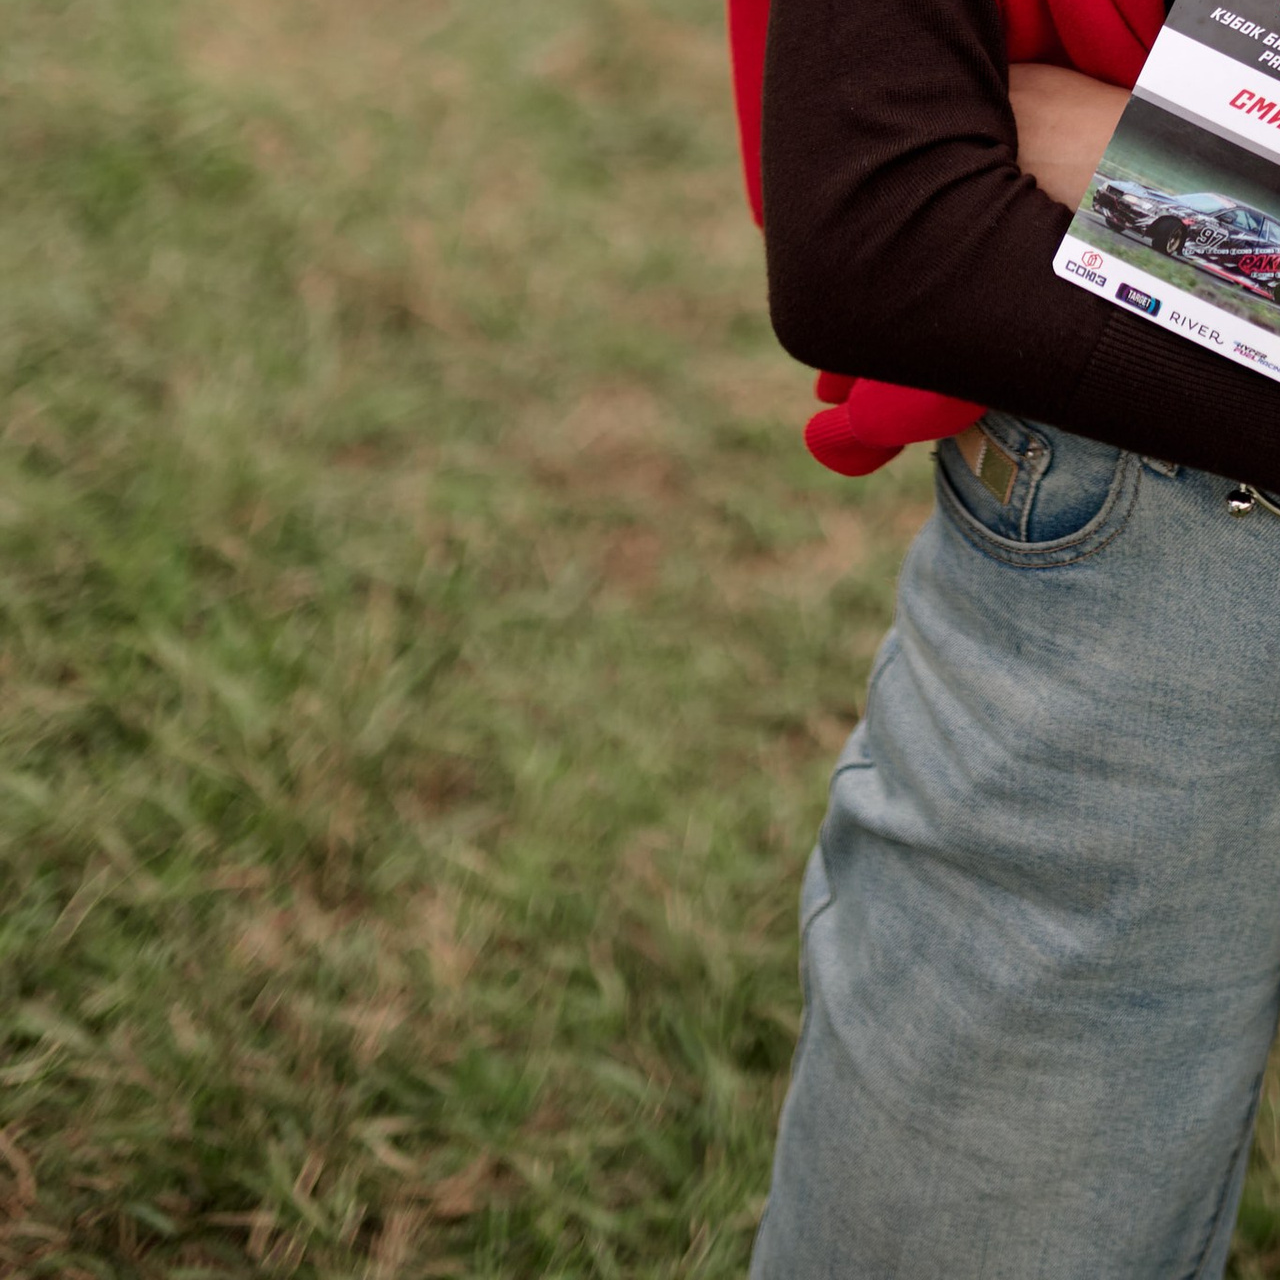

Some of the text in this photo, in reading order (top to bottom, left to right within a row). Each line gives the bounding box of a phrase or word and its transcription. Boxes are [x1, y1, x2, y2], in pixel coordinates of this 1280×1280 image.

[1210, 7, 1266, 40] КУБОК
[1196, 227, 1228, 248] 97
[1065, 260, 1107, 288] СОЮЗ
[1127, 289, 1152, 308] TARGET
[1169, 311, 1224, 345] RIVER
